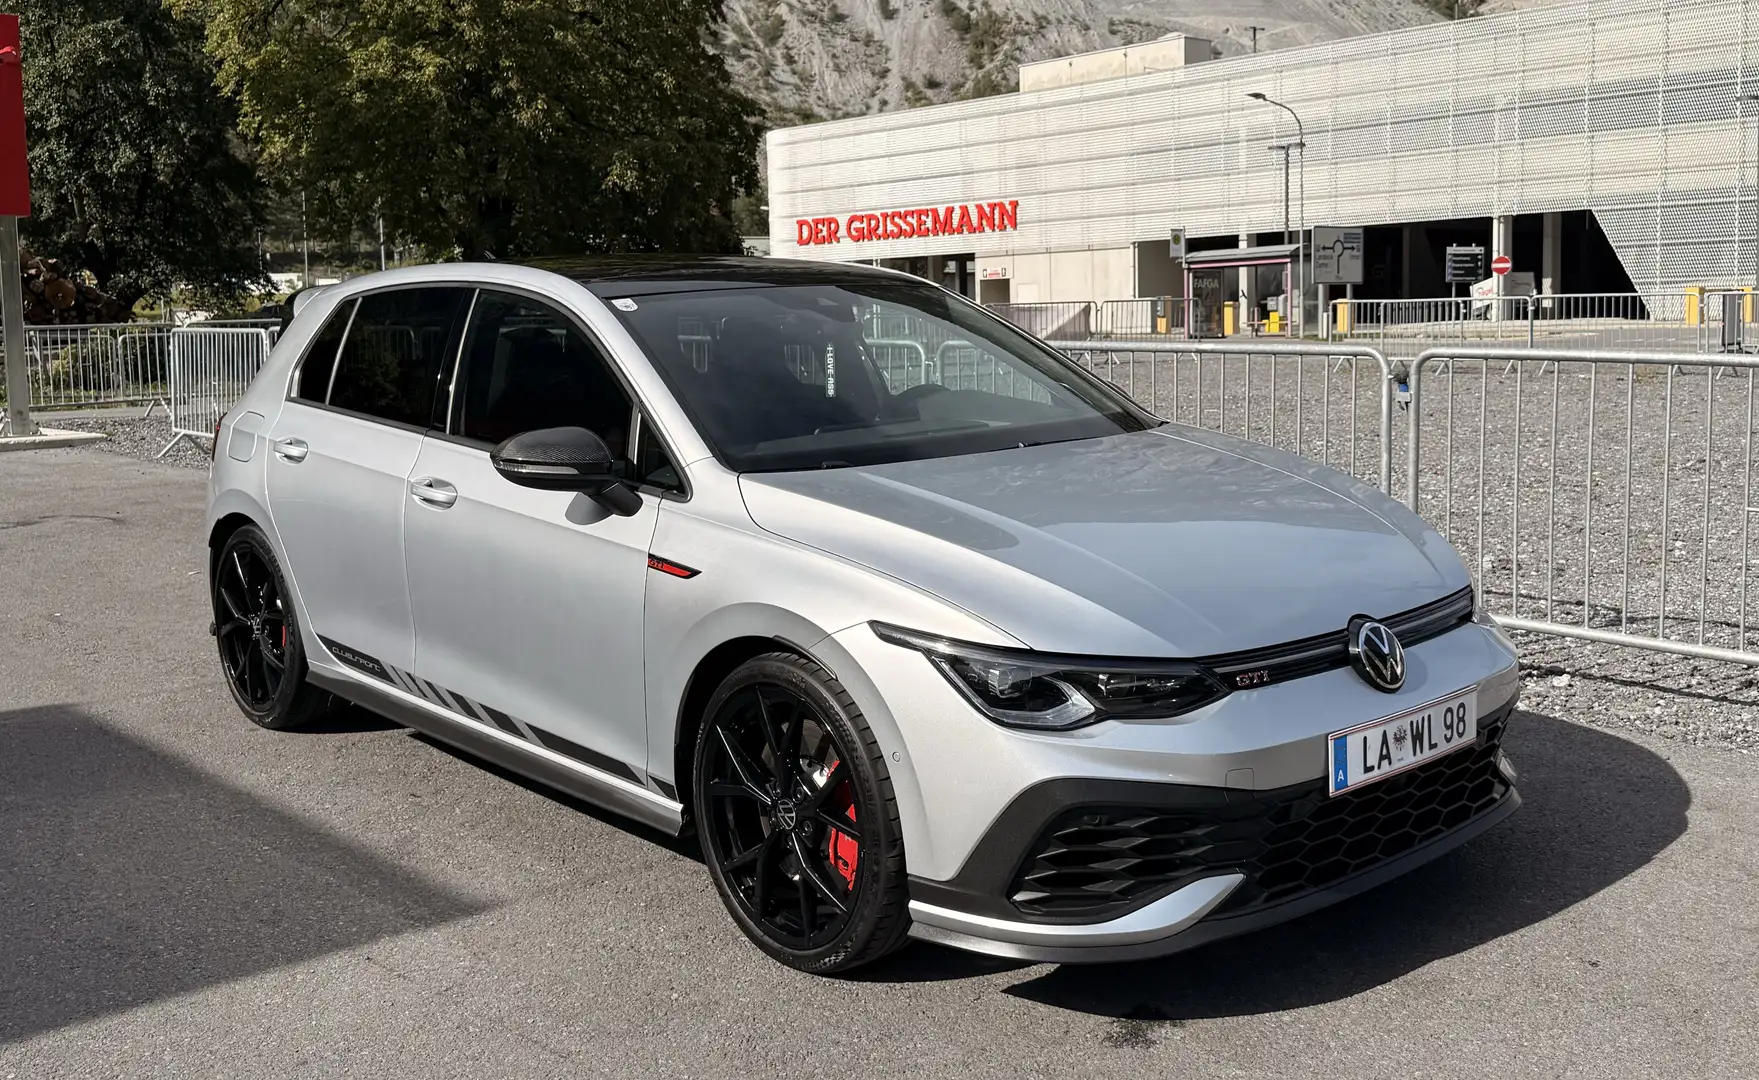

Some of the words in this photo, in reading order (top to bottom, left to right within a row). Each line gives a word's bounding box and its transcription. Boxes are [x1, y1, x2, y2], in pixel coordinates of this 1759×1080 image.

[796, 217, 840, 246] DER
[846, 200, 1019, 243] GRISSEMANN
[1236, 670, 1270, 687] GTI
[1362, 729, 1393, 775] LA
[1409, 713, 1438, 757] WL
[1443, 701, 1467, 744] 98
[1336, 768, 1346, 783] A
